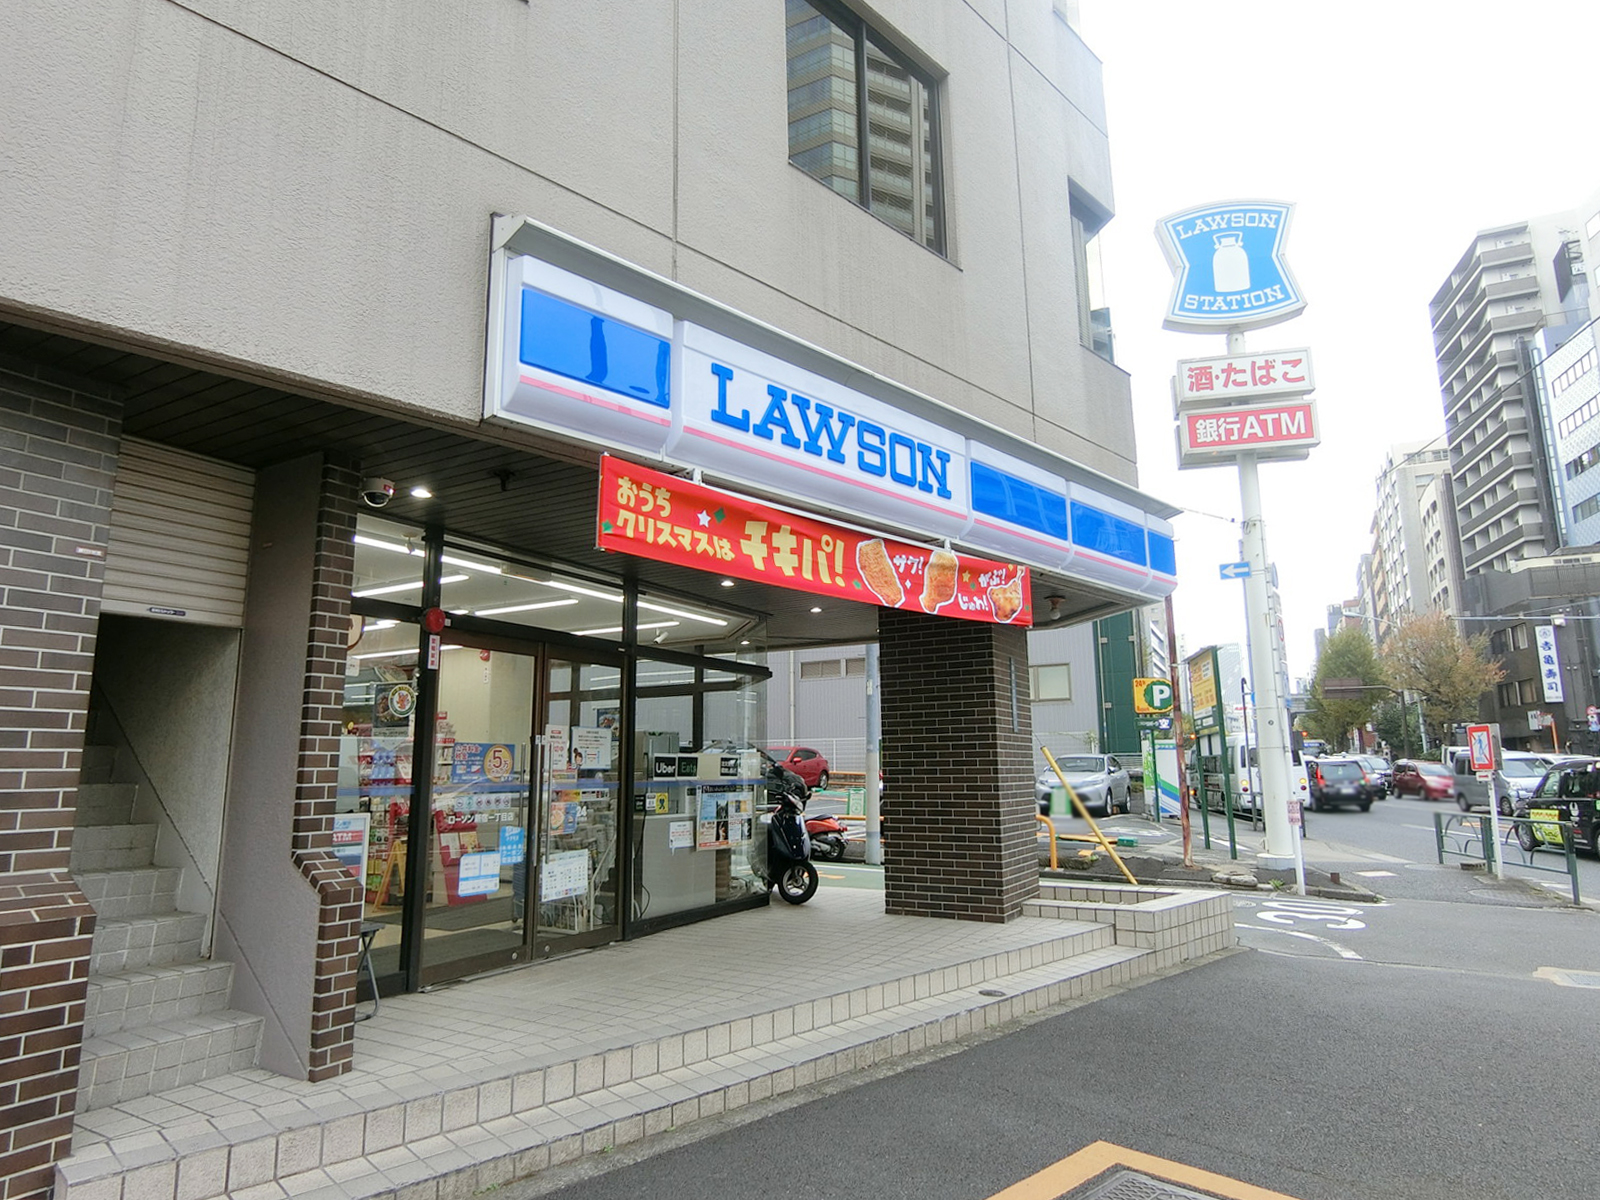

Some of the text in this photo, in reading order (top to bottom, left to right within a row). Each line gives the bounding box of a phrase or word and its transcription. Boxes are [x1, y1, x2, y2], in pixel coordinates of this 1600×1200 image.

[1176, 212, 1278, 240] LAWSON
[1184, 284, 1285, 311] STATION
[1187, 357, 1306, 392] 酒・たばこ
[711, 362, 952, 500] LAWSON
[1195, 411, 1306, 443] 銀行ATM
[616, 476, 672, 518] おうち
[616, 508, 736, 562] クリスマスは
[740, 520, 846, 588] チキパ!
[1152, 684, 1171, 707] P
[655, 761, 697, 774] Uber Eats
[576, 805, 588, 817] 24
